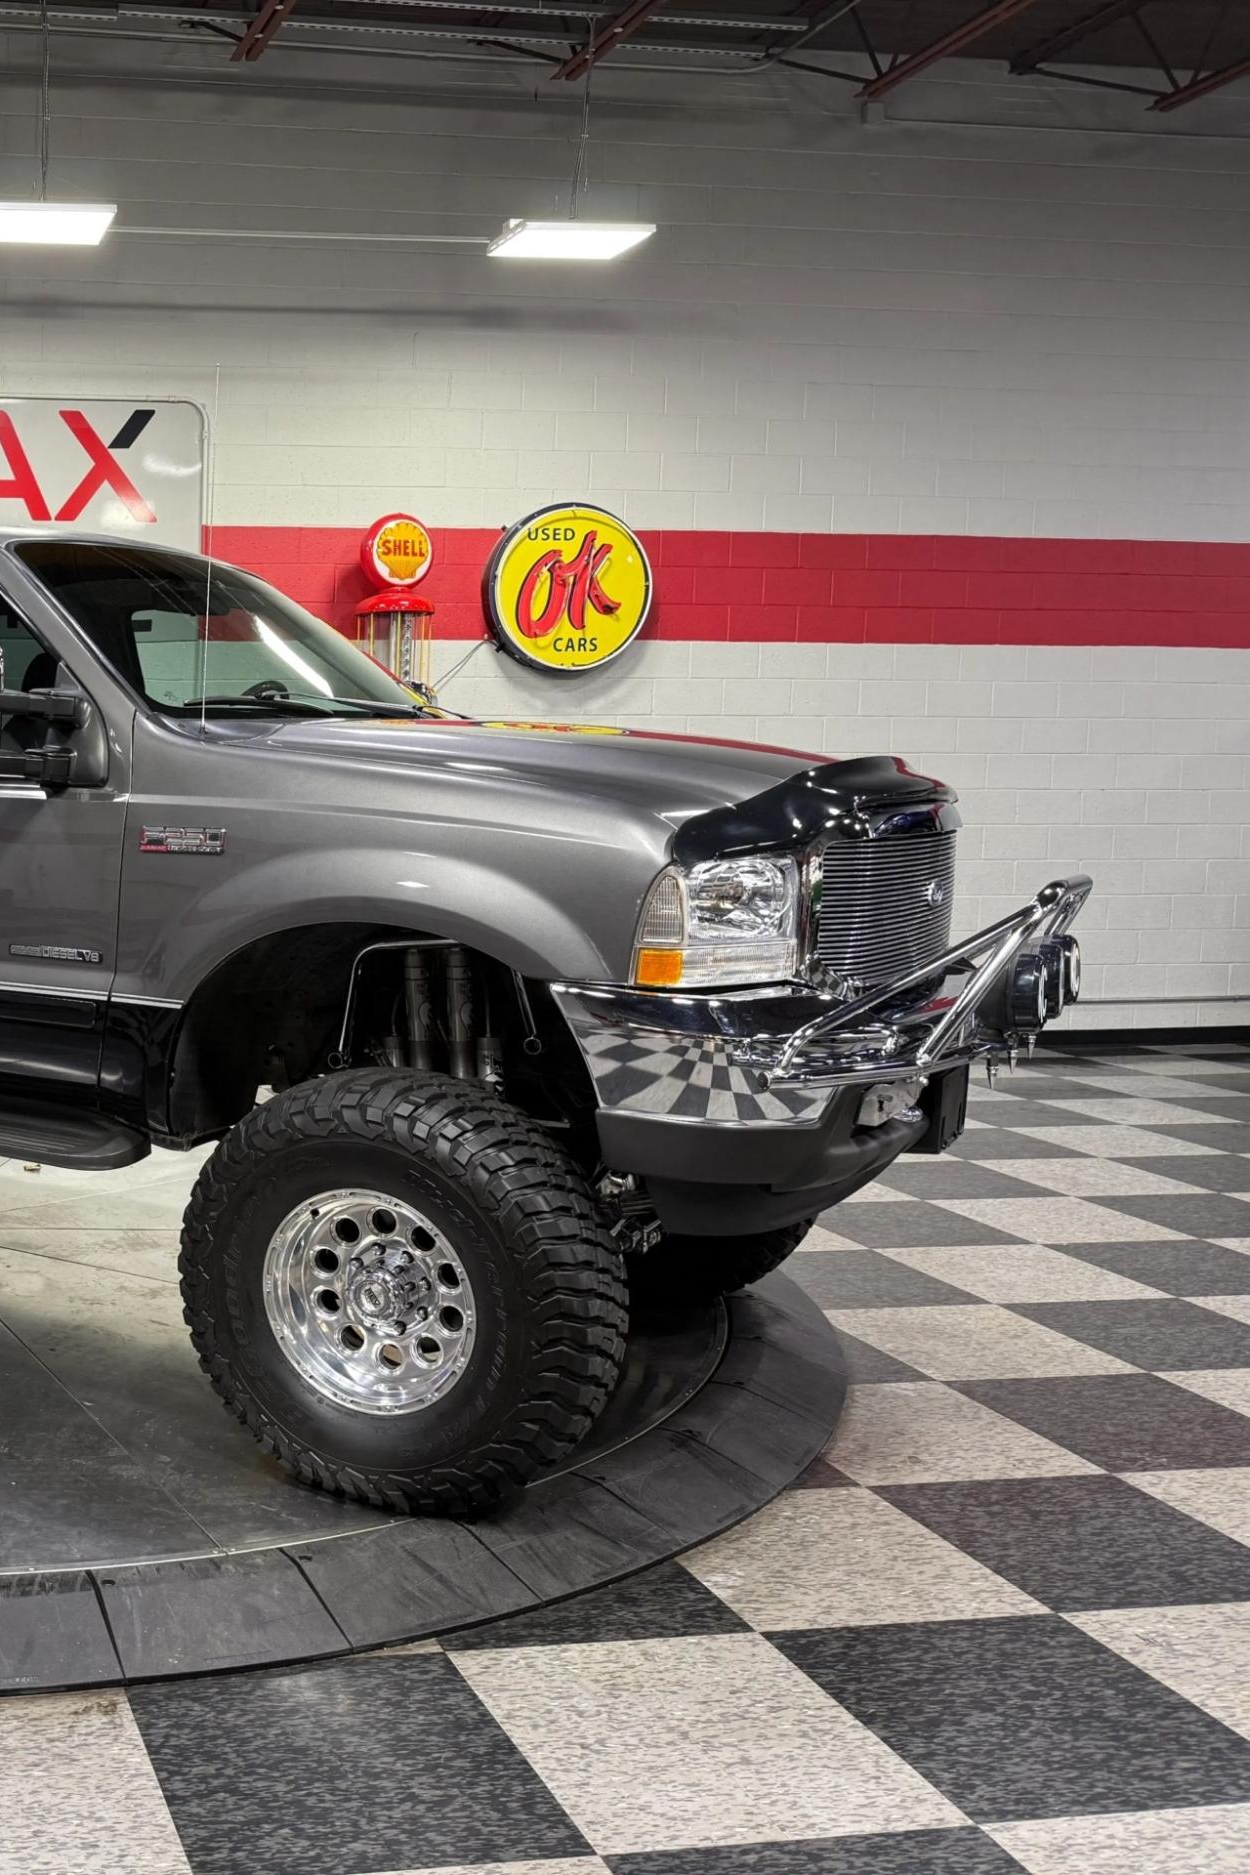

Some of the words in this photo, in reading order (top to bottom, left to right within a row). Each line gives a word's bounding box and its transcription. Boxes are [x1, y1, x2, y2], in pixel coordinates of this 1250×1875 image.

[526, 527, 575, 542] USED
[381, 538, 426, 558] SHELL
[515, 530, 622, 639] OK
[553, 637, 597, 652] CARS
[41, 945, 82, 961] DIESEL
[77, 949, 100, 962] V8
